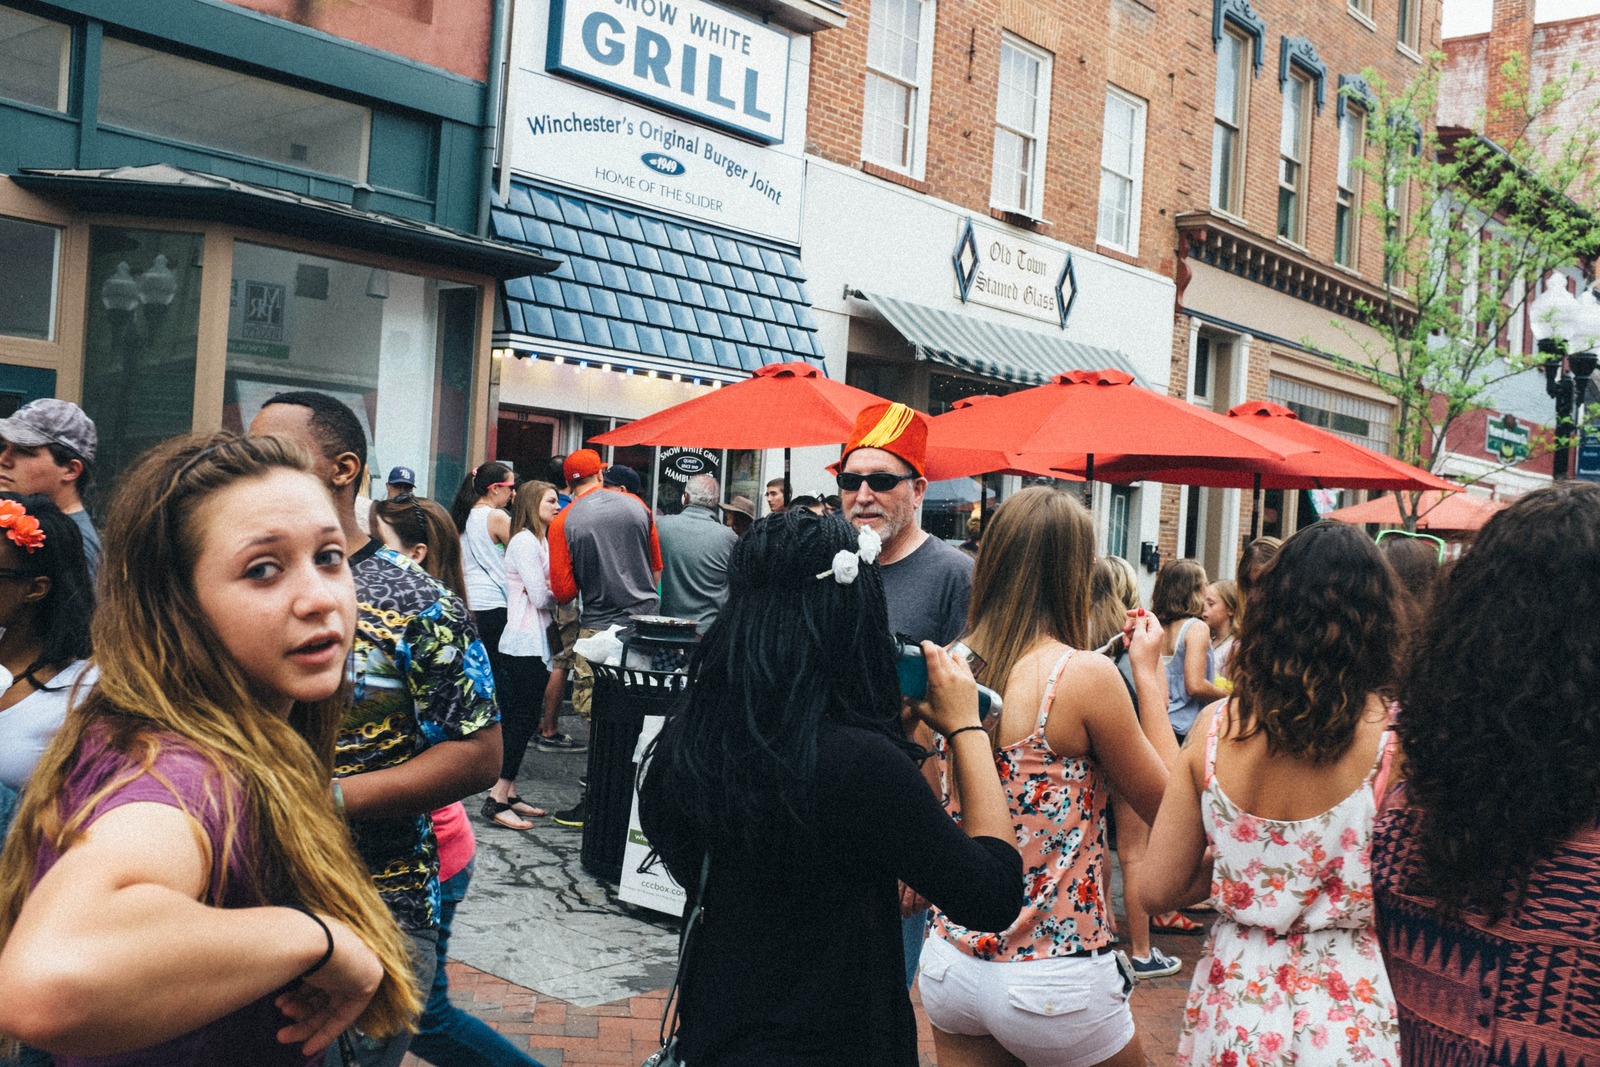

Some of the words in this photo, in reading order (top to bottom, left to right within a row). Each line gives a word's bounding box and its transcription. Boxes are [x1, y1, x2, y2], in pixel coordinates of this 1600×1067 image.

[614, 0, 678, 26] NOW
[690, 13, 752, 56] WHITE
[581, 10, 771, 122] GRILL
[526, 111, 634, 136] Winchester's
[639, 120, 699, 155] Original
[703, 142, 748, 180] Burger
[749, 171, 782, 205] Joint
[657, 156, 678, 173] 1949
[595, 166, 636, 189] HOME
[638, 179, 656, 193] OF
[660, 184, 682, 202] THE
[685, 191, 723, 213] SLIDER
[989, 241, 1011, 266] Old
[1016, 249, 1047, 277] Town
[975, 270, 1018, 301] Stained
[1023, 284, 1055, 311] Glass
[660, 446, 680, 460] SNOW
[703, 450, 720, 466] GRILL
